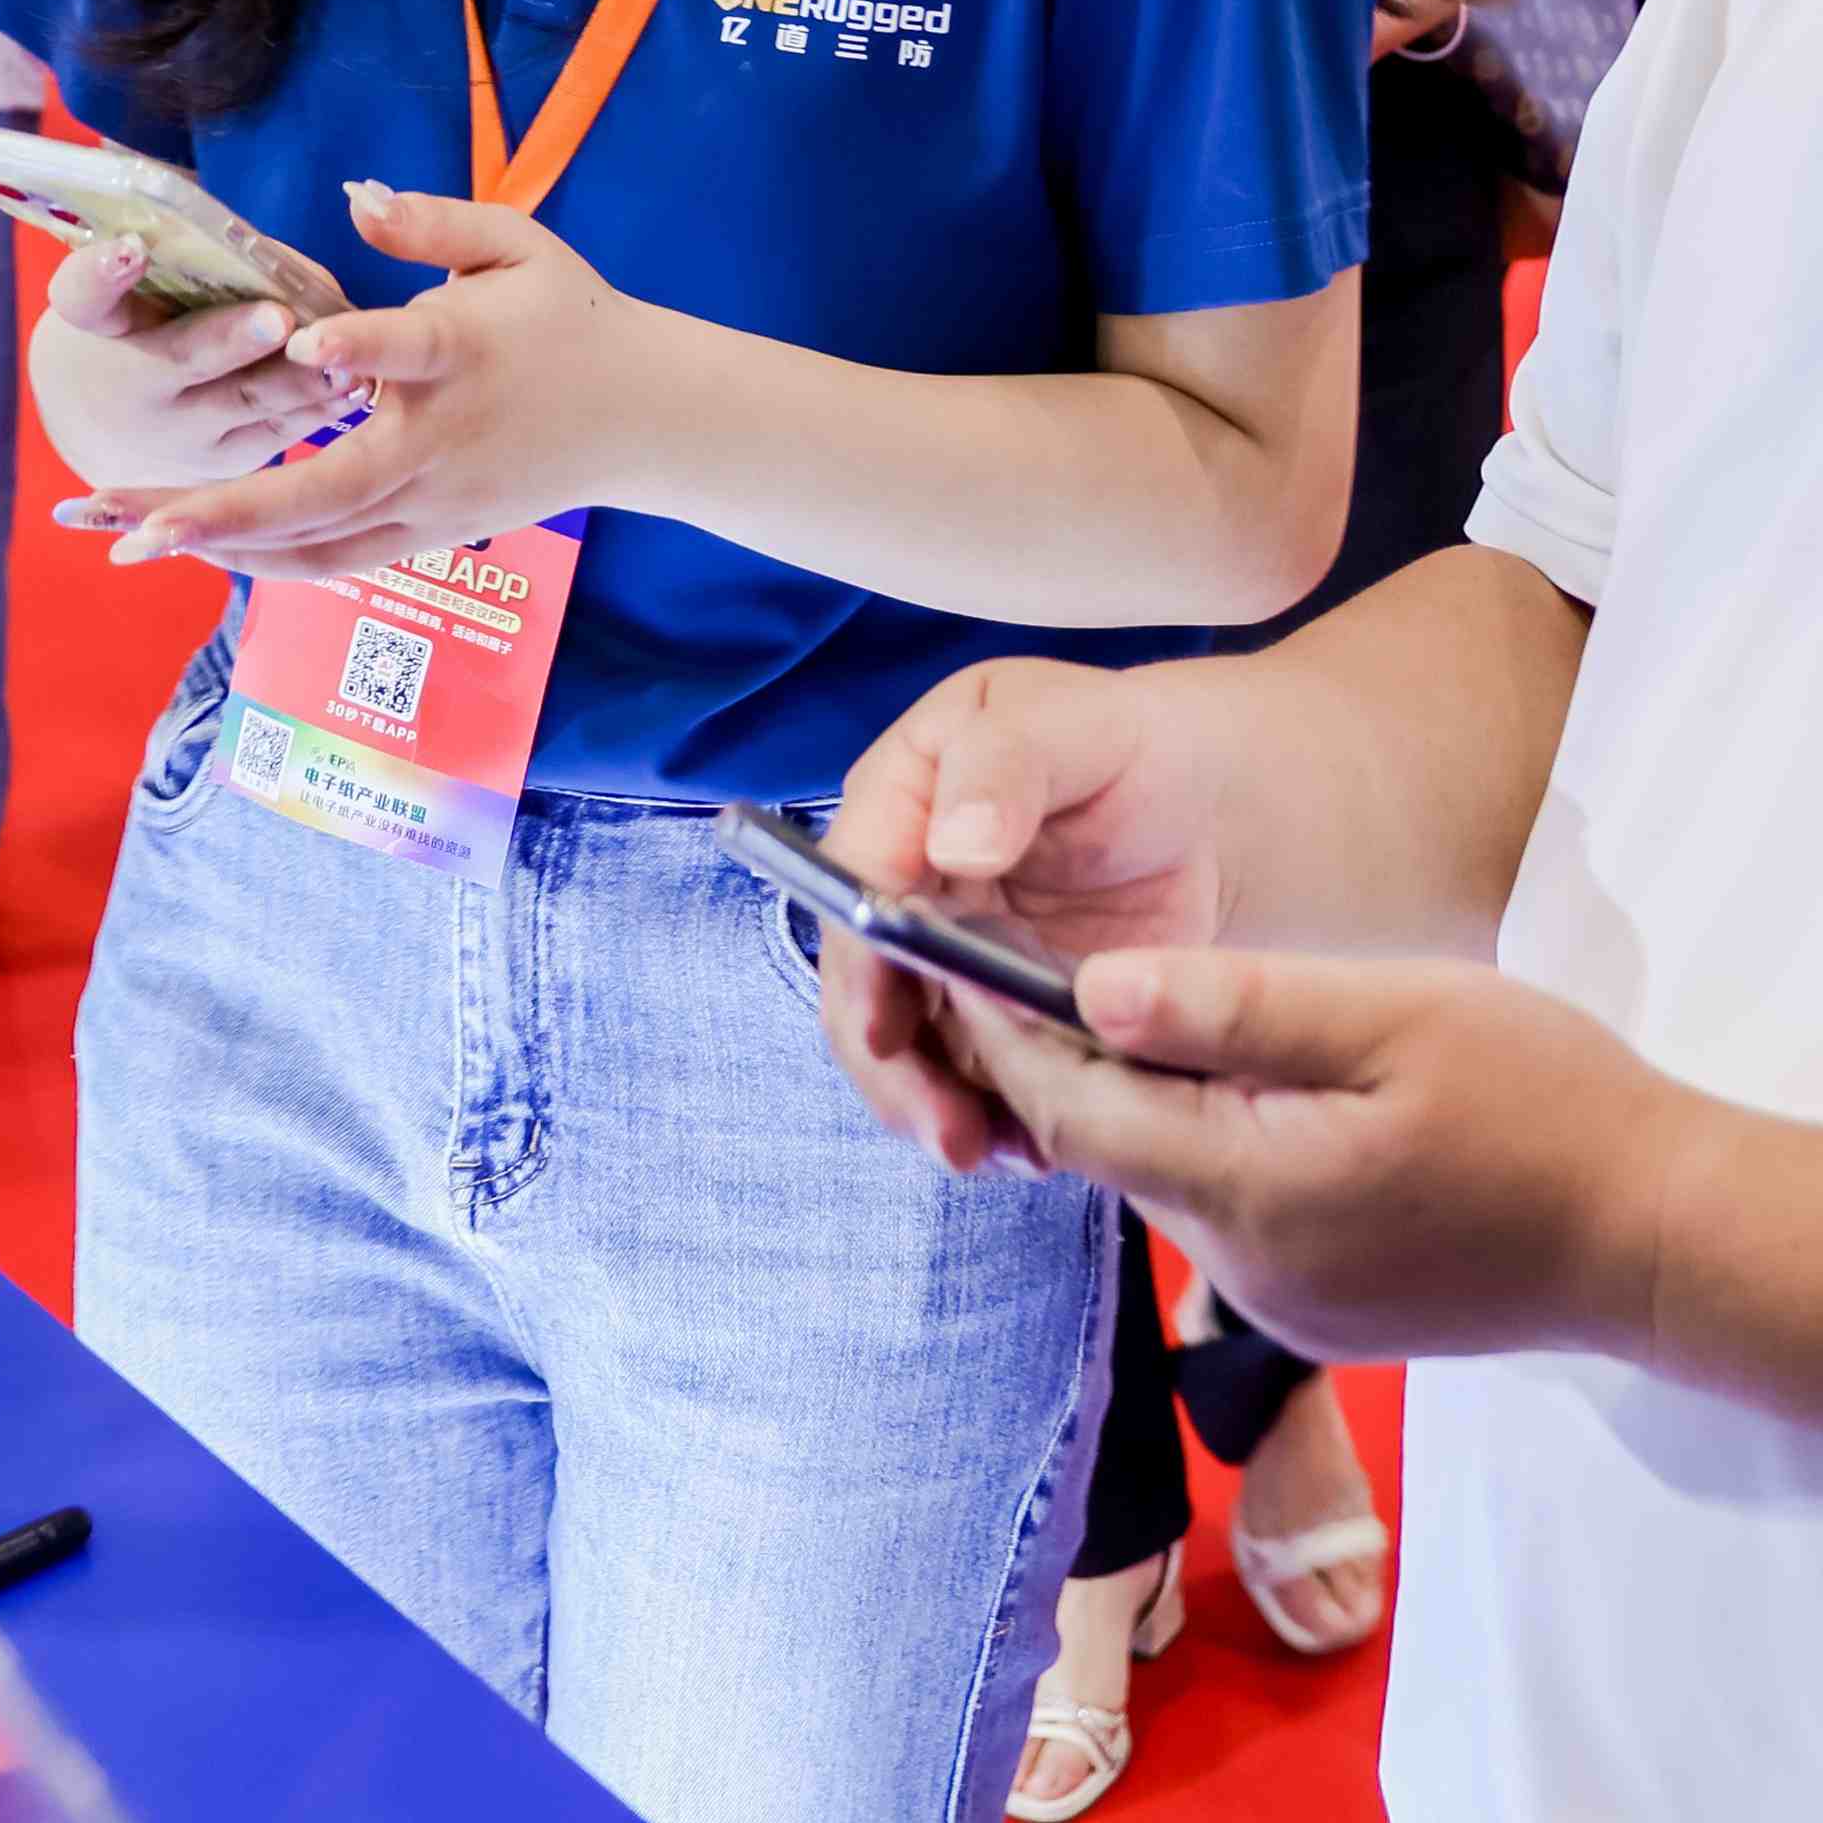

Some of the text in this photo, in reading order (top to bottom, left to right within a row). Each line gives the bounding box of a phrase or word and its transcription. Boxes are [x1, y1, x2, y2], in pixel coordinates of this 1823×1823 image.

[720, 16, 934, 68] 亿道三防
[304, 766, 428, 824] 电子纸产业联盟
